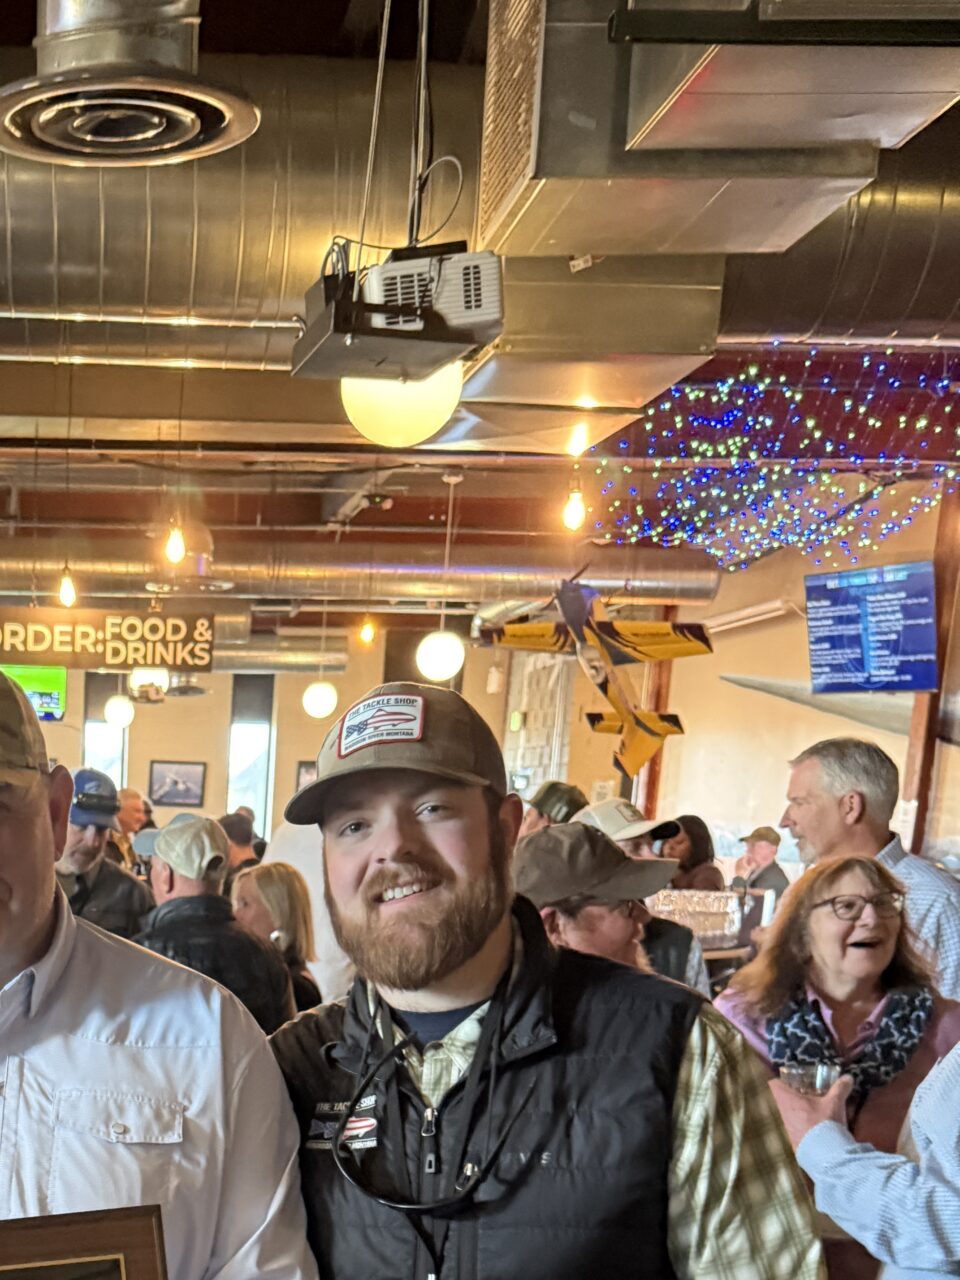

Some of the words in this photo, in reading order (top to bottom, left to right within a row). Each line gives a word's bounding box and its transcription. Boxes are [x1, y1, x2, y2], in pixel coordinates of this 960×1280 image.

[105, 616, 187, 641] FOOD
[193, 618, 213, 642] &
[105, 641, 211, 665] DRINKS
[363, 698, 392, 710] TACKLE
[394, 697, 418, 705] SHOP
